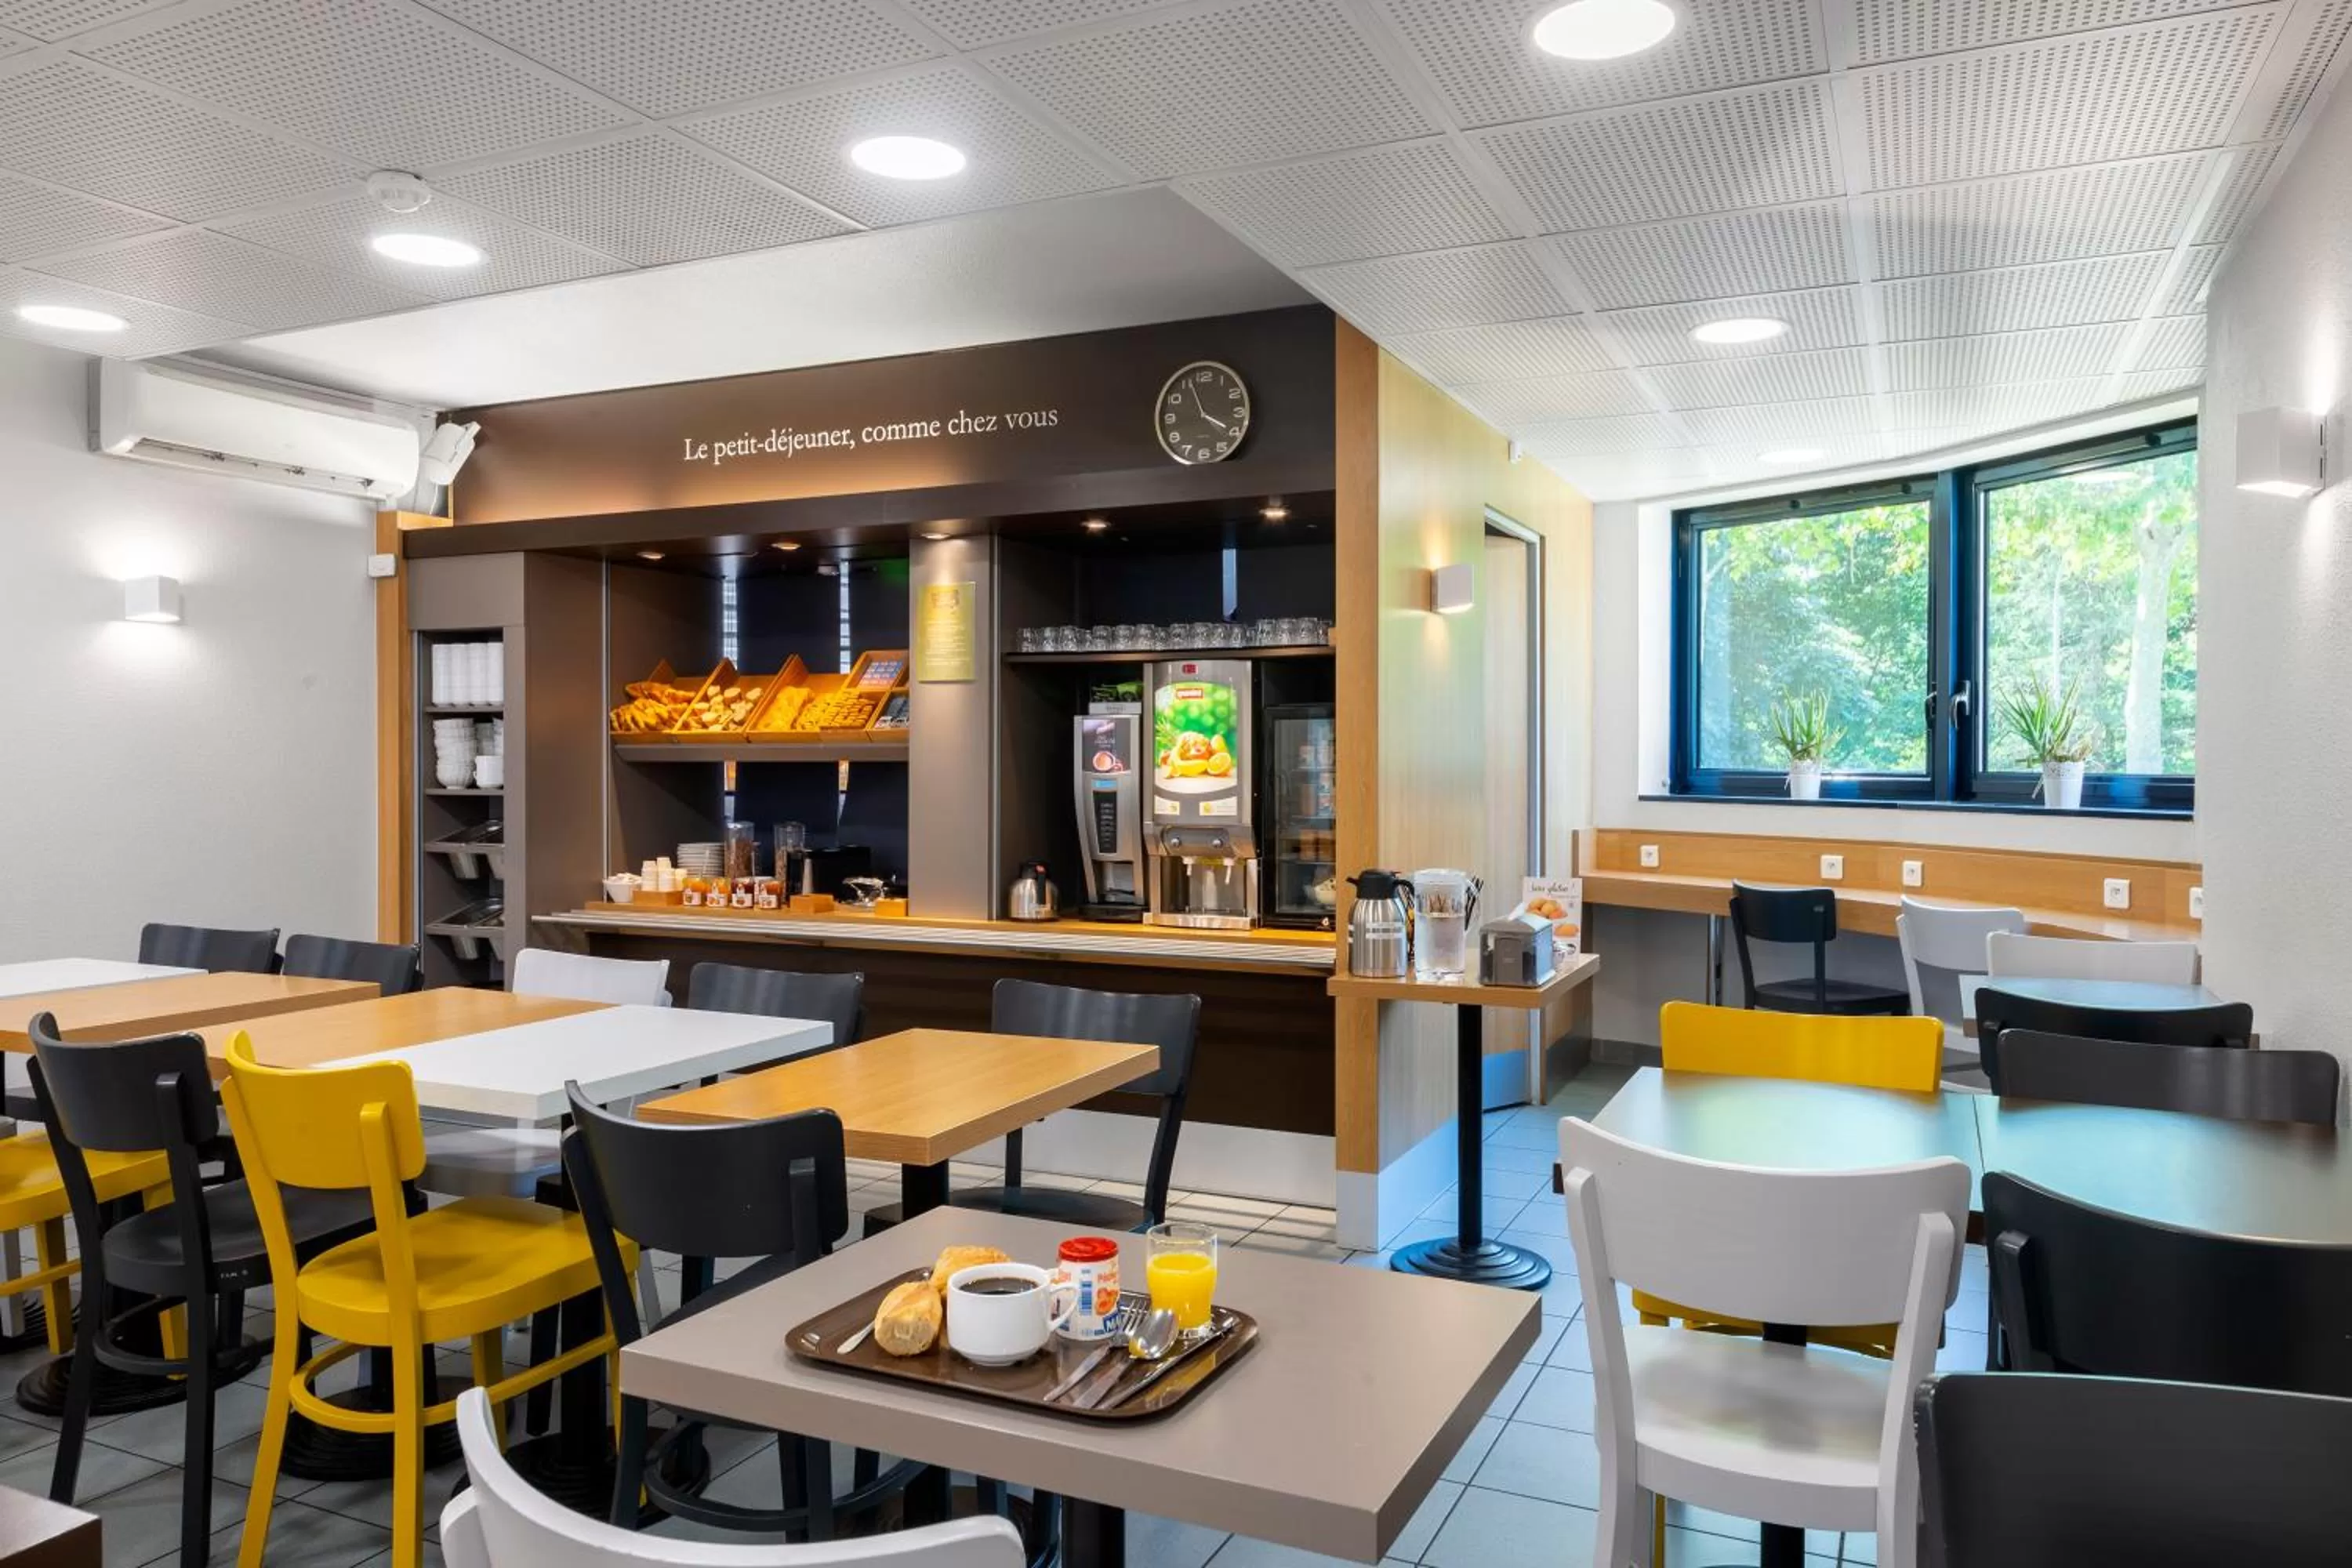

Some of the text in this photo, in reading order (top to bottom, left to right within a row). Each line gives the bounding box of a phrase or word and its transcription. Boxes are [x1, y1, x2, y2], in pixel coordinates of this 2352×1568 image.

[1196, 371, 1213, 382] 12
[1229, 388, 1241, 399] 2
[1167, 394, 1181, 405] 10
[1232, 407, 1244, 418] 3
[1164, 413, 1175, 424] 9
[684, 409, 1058, 465] Le petit-déjeuner, comme chez vous
[1229, 426, 1240, 437] 4
[1169, 432, 1180, 443] 8
[1182, 445, 1192, 456] 7
[1197, 448, 1210, 459] 6
